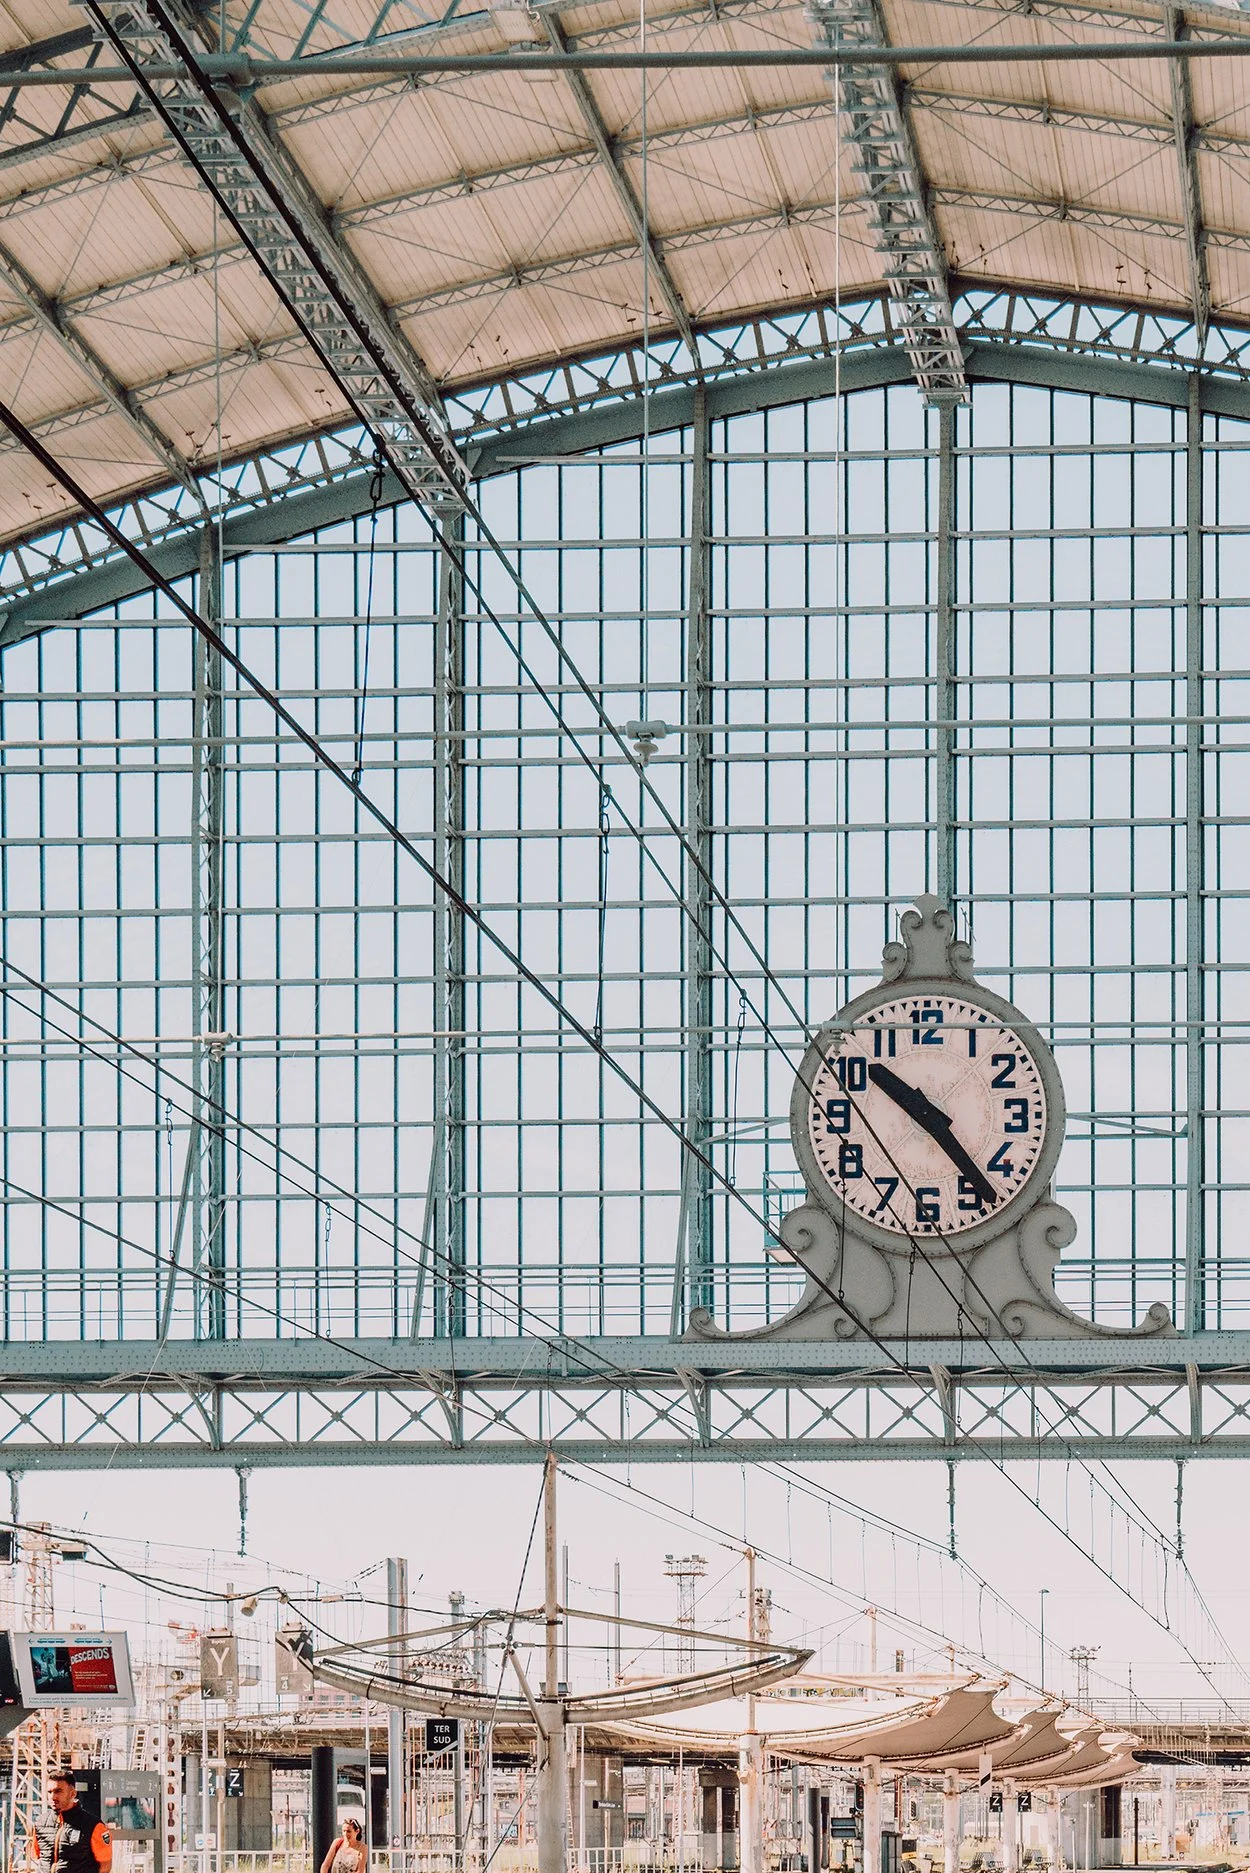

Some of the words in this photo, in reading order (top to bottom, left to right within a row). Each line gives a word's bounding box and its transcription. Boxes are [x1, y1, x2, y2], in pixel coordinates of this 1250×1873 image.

[874, 1022, 896, 1058] 11
[910, 1009, 944, 1045] 12
[965, 1022, 976, 1058] 1
[836, 1056, 867, 1092] 10
[991, 1053, 1016, 1089] 2
[826, 1099, 850, 1134] 9
[1004, 1098, 1029, 1133] 3
[838, 1144, 863, 1179] 8
[987, 1141, 1014, 1178] 4
[874, 1177, 899, 1212] 7
[915, 1187, 940, 1223] 6
[957, 1175, 982, 1211] 5
[70, 1647, 110, 1665] DESCENDS
[209, 1647, 230, 1676] Y
[285, 1642, 305, 1671] Y
[226, 1685, 233, 1695] 5
[281, 1680, 288, 1690] 4
[433, 1736, 451, 1744] SUD
[434, 1725, 450, 1733] TER
[229, 1772, 240, 1787] Z
[992, 1795, 1000, 1806] Z
[1021, 1795, 1029, 1806] Z
